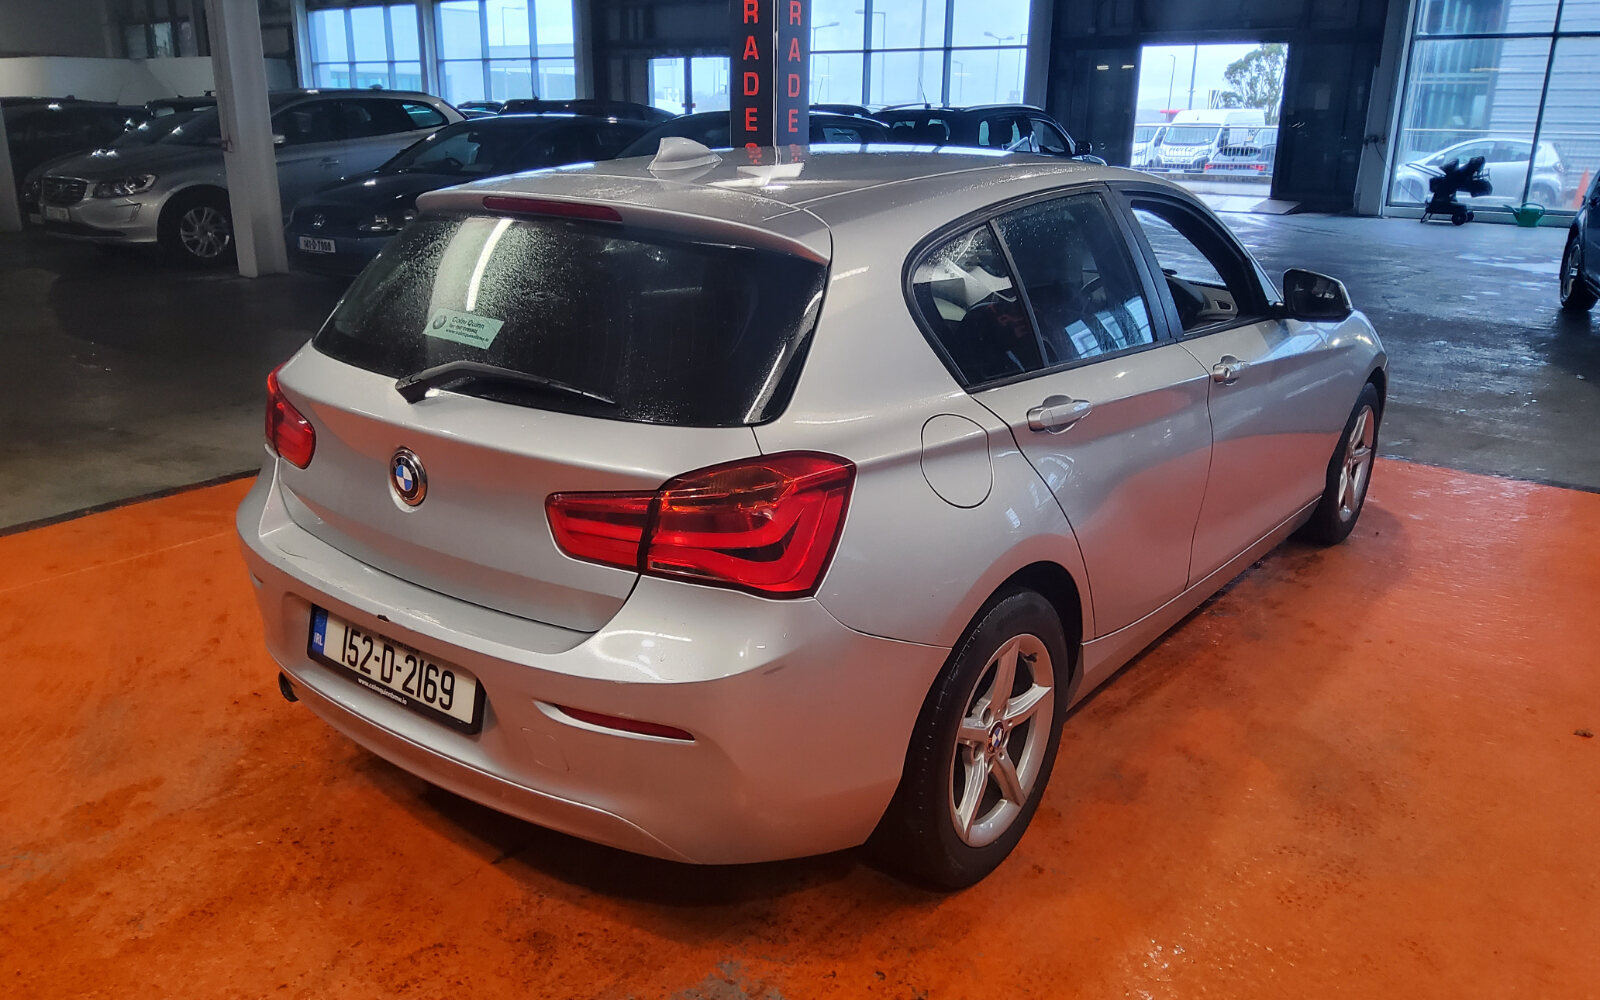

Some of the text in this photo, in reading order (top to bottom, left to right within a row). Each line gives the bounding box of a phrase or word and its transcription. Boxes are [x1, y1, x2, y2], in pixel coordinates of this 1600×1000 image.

[467, 319, 485, 330] Quinn
[314, 631, 324, 647] IRL
[341, 625, 456, 711] 152-D-2169
